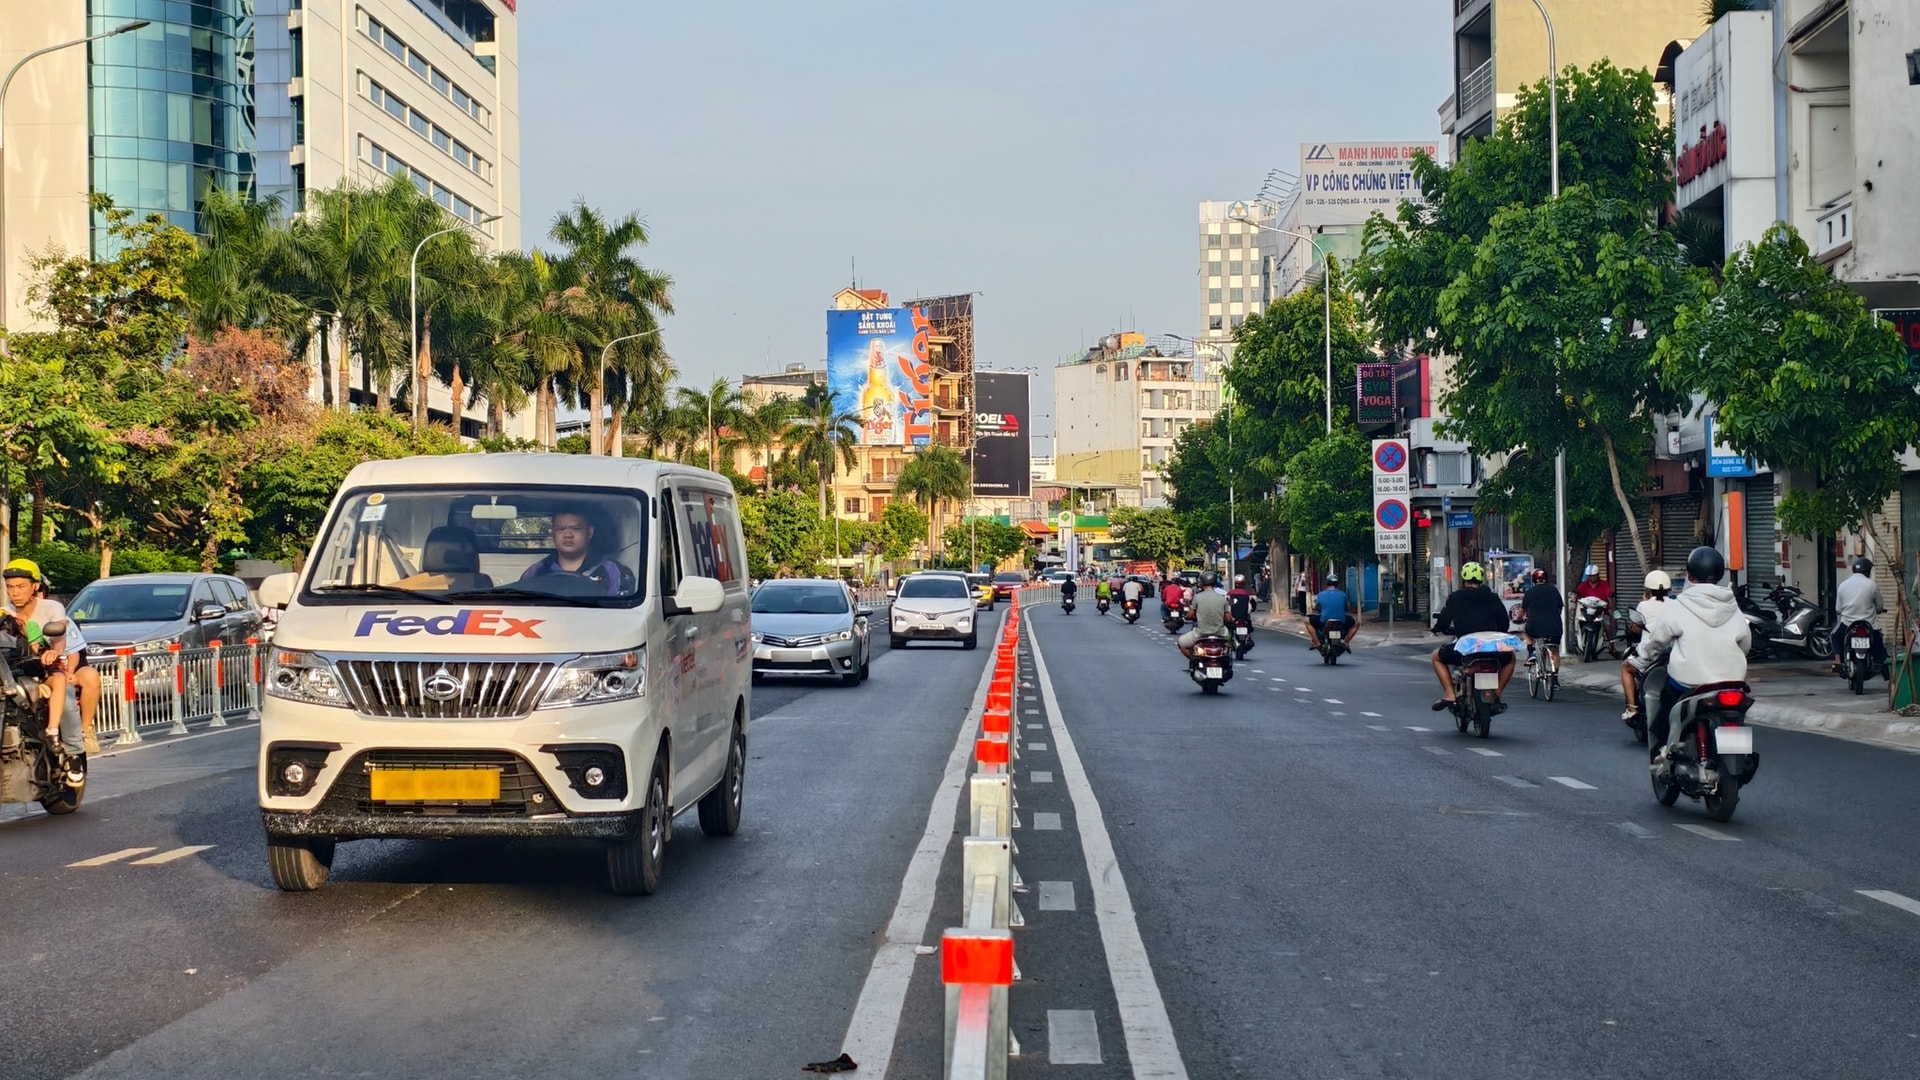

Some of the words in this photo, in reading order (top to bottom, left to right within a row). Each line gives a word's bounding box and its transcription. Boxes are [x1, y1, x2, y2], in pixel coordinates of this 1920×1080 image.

[1306, 174, 1320, 191] VP
[1322, 169, 1350, 192] CÔNG
[1352, 168, 1387, 191] CHỨNG
[1389, 168, 1411, 195] VIỆT
[1364, 381, 1389, 392] GYM
[1362, 395, 1392, 406] YOGA
[864, 416, 893, 435] Tiger
[354, 609, 547, 639] FedEx
